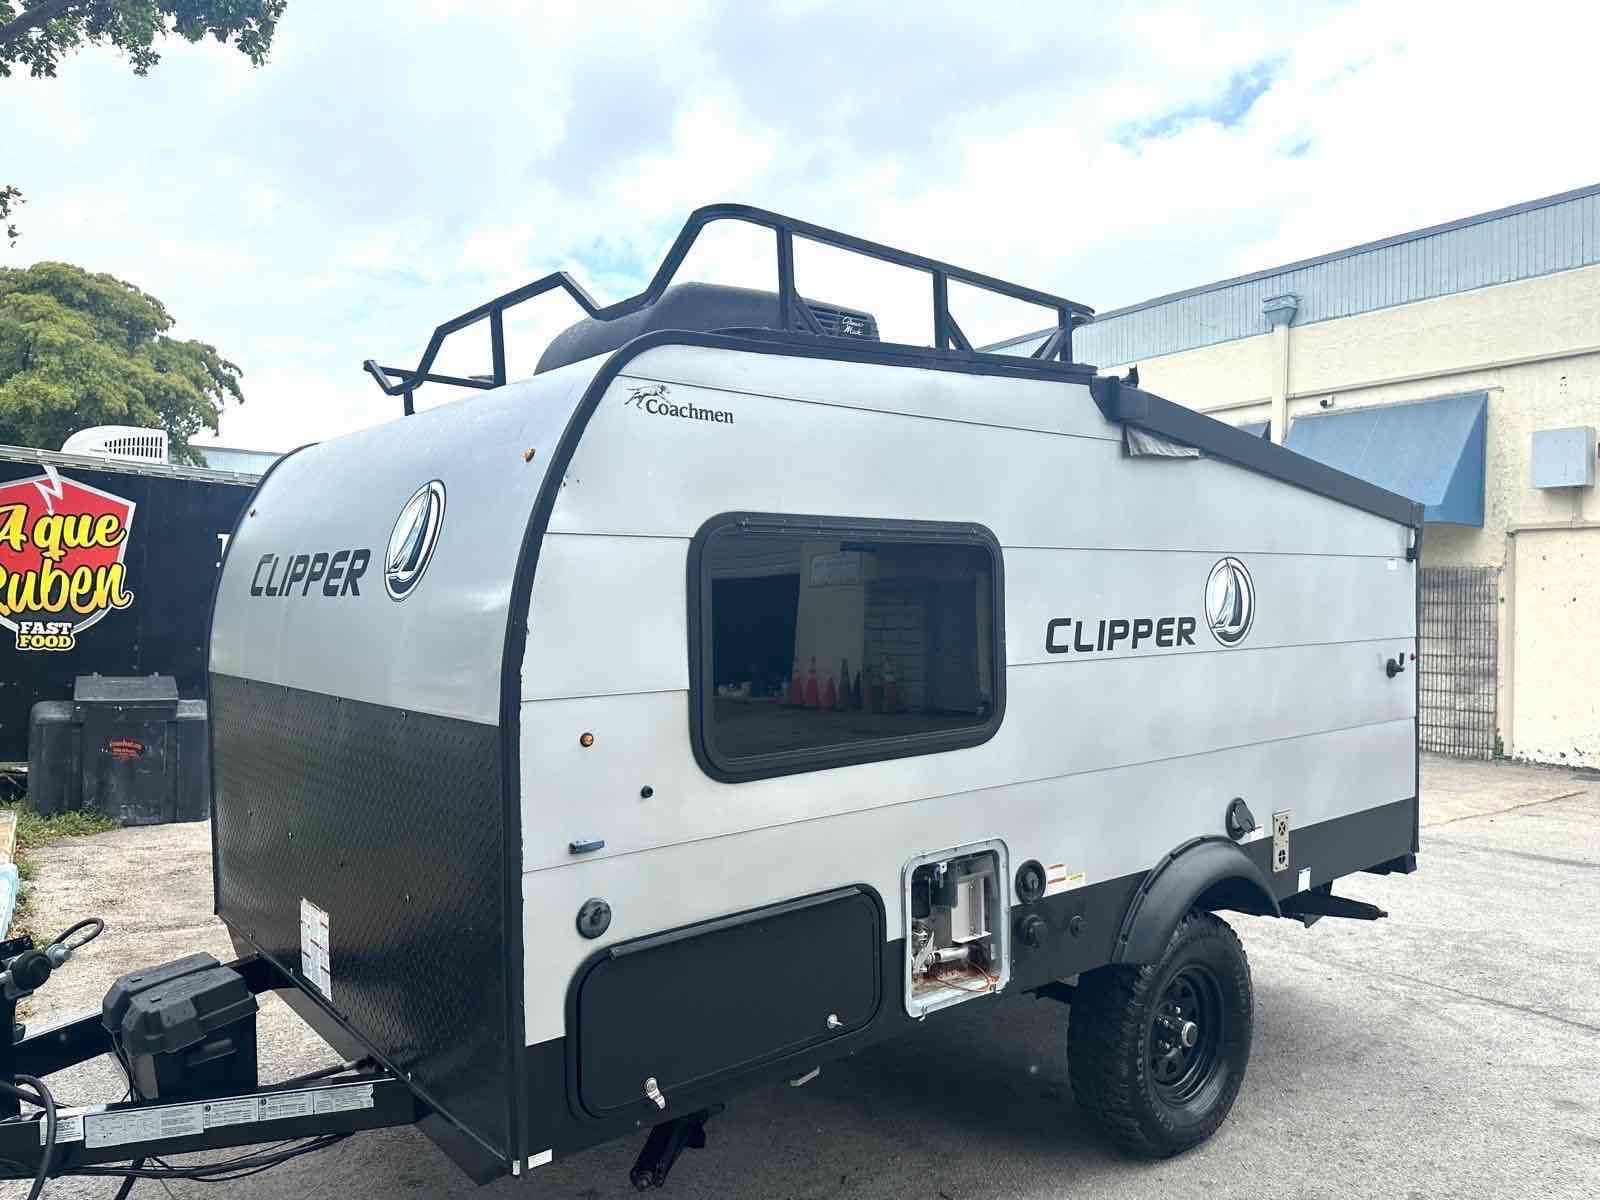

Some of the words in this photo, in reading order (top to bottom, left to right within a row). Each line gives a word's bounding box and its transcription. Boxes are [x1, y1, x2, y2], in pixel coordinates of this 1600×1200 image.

[645, 398, 734, 425] Coachmen
[33, 512, 127, 561] que
[250, 548, 371, 597] CLIPPER
[20, 622, 72, 635] FAST
[20, 636, 72, 648] FOOD
[1045, 616, 1197, 654] CLIPPER
